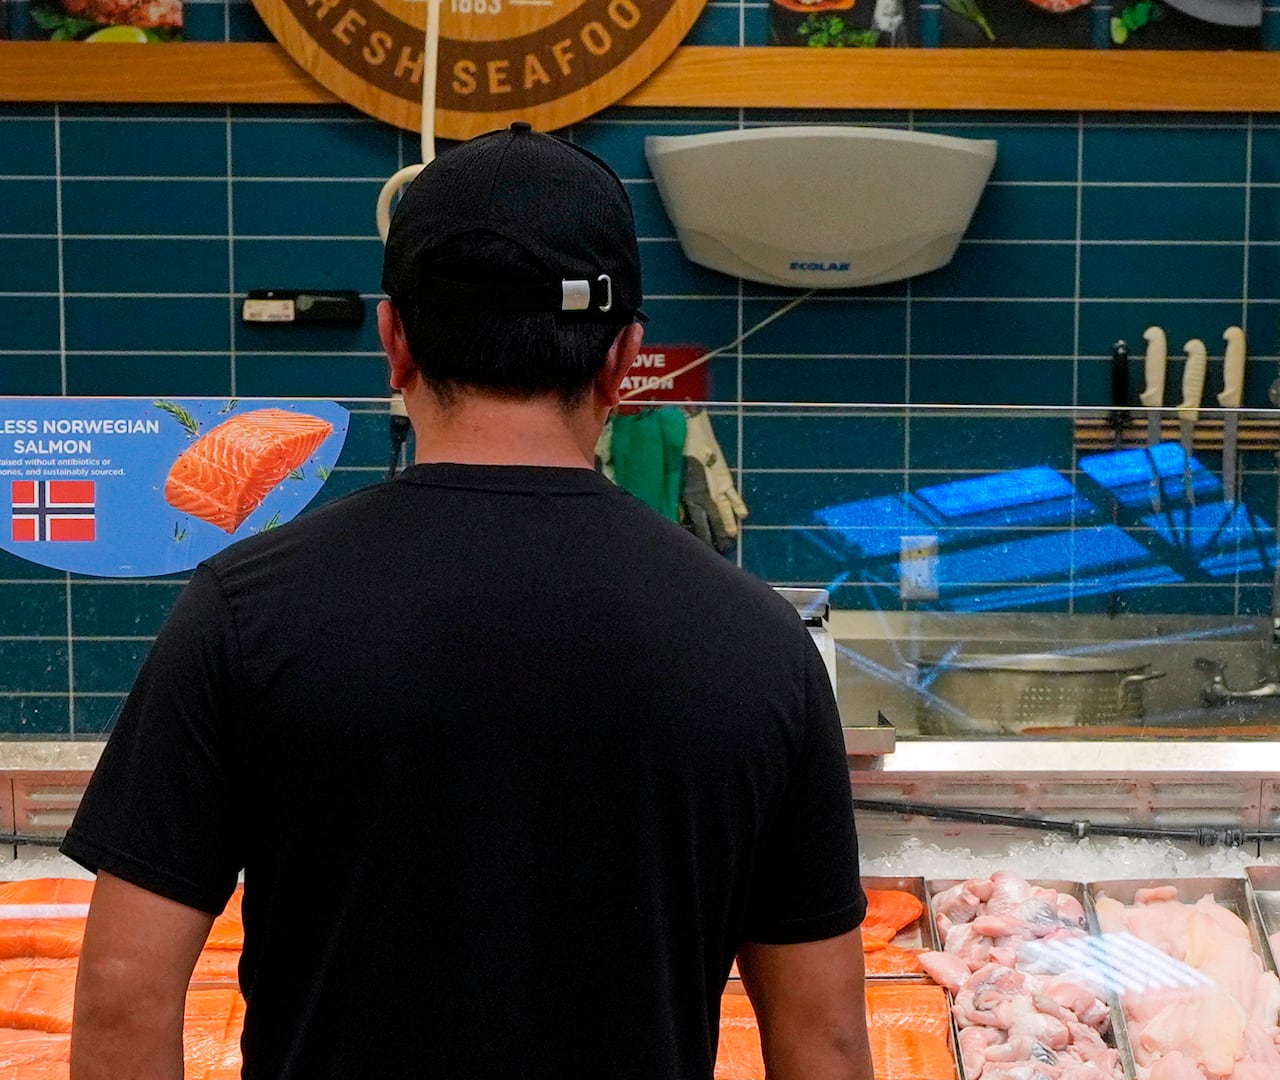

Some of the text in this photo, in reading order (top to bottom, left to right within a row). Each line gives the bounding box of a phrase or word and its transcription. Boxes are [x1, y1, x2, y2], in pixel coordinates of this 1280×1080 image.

[43, 419, 160, 435] NORWEGIAN
[13, 439, 92, 454] SALMON
[24, 458, 56, 466] without
[57, 458, 99, 466] antibiotics
[25, 468, 41, 476] and
[42, 468, 90, 478] sustainably
[91, 468, 126, 476] sourced.
